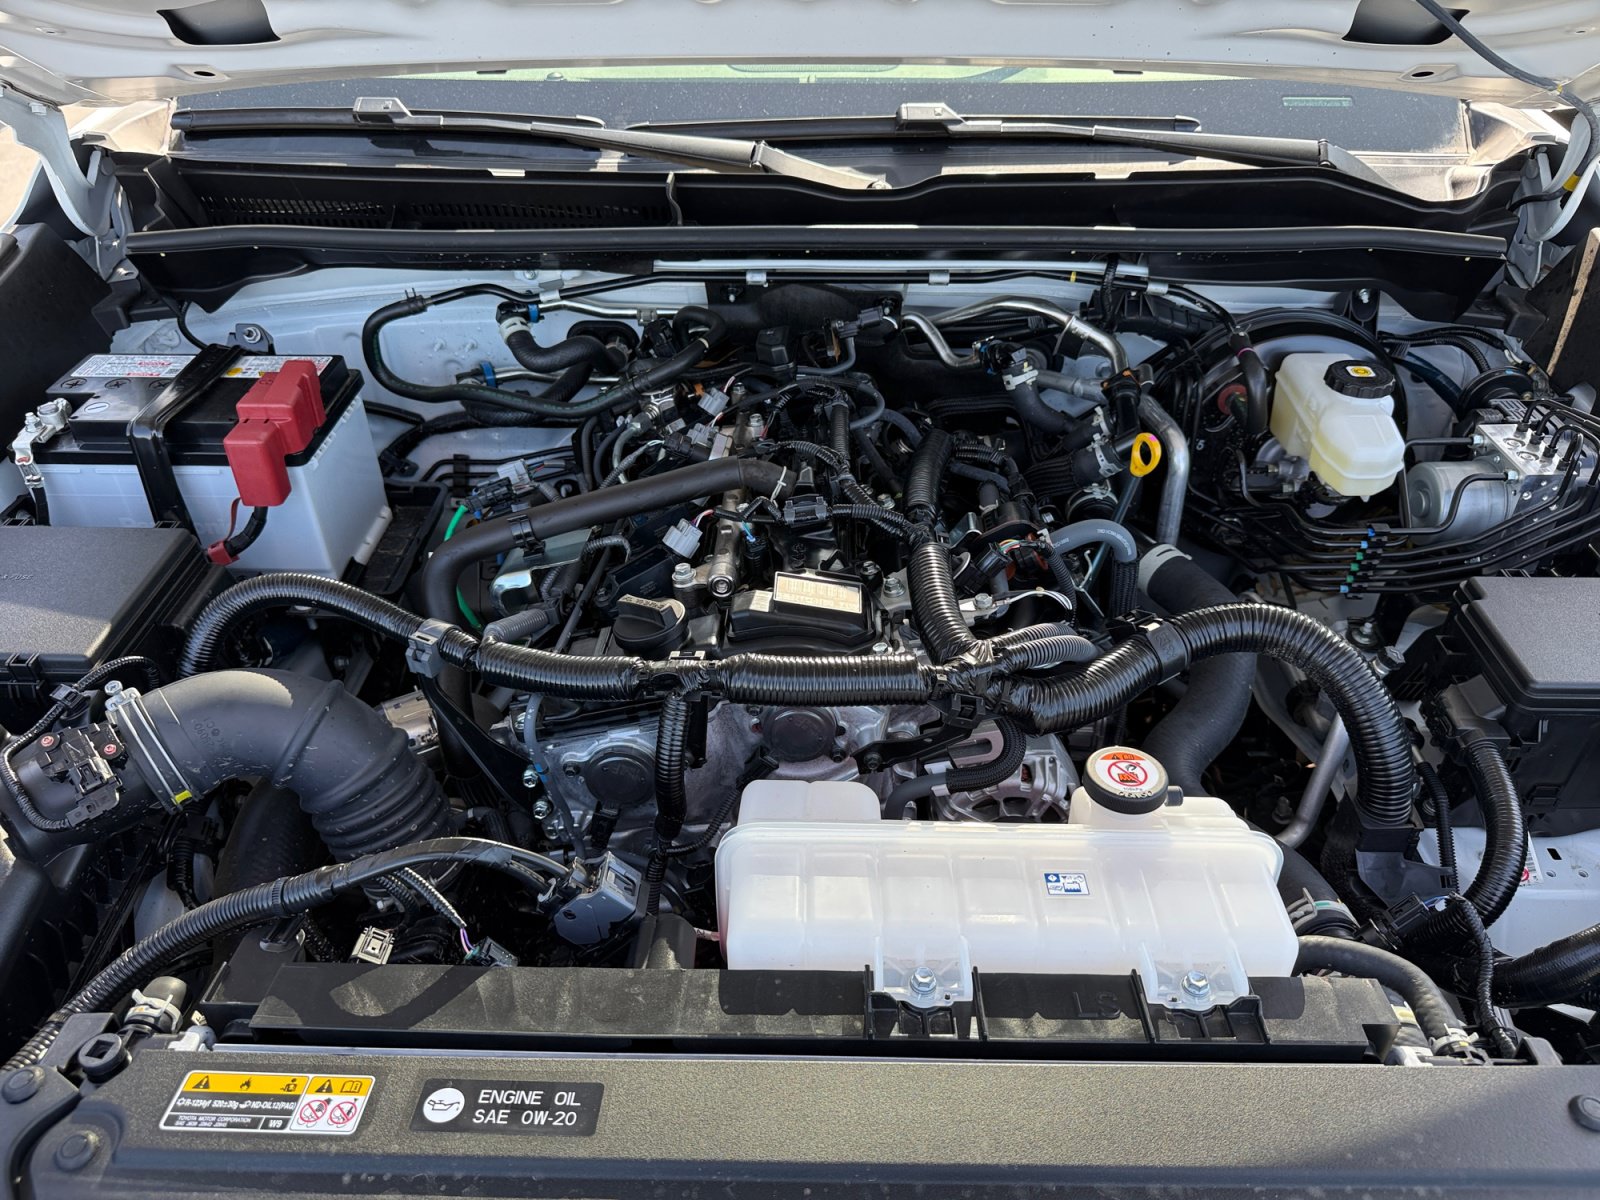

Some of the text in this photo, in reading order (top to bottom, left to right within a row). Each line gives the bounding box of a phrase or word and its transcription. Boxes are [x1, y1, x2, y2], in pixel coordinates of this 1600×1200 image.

[1118, 790, 1153, 798] DENSO
[478, 1089, 581, 1106] ENGINE OIL
[268, 1119, 283, 1128] W9
[472, 1109, 577, 1126] SAE 0W-20
